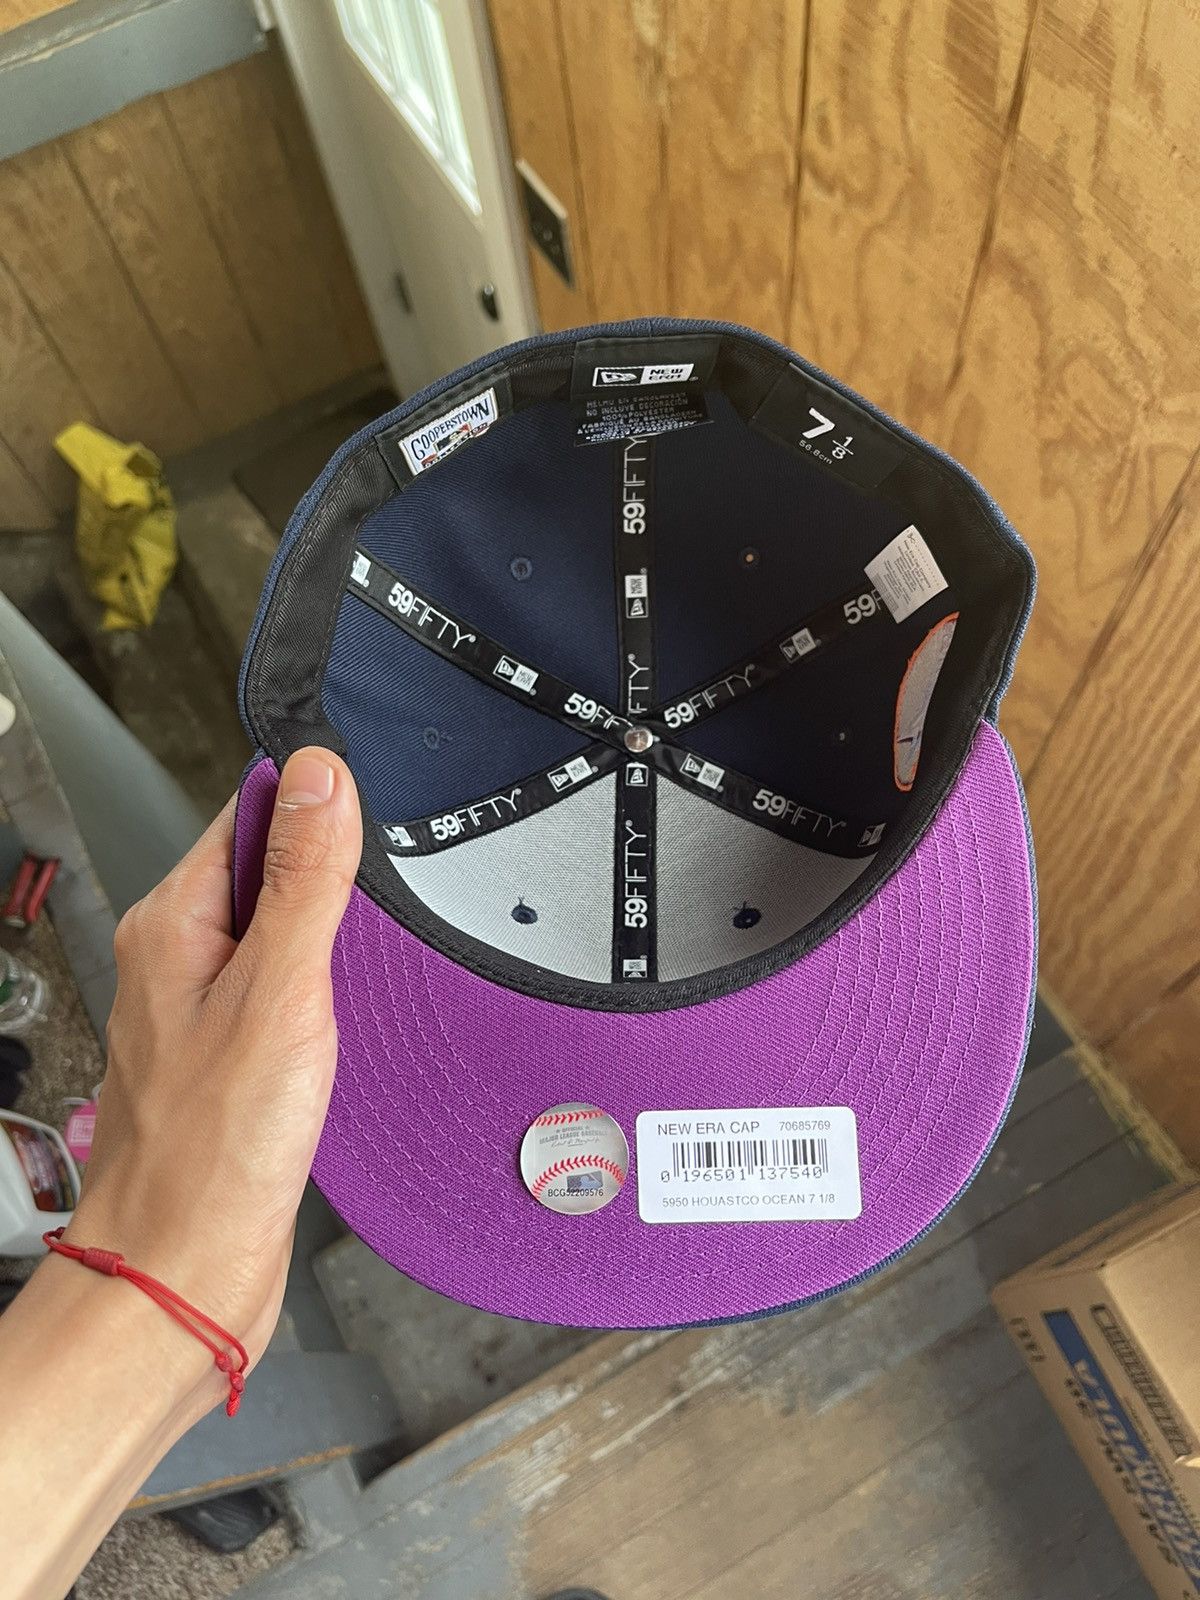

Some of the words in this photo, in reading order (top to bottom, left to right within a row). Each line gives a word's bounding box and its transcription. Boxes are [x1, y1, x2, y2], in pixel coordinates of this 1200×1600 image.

[410, 398, 490, 461] COOPERSTOWN
[802, 407, 836, 439] 7
[798, 439, 833, 464] 56.8cm
[388, 582, 472, 649] 59FIFTY
[663, 665, 751, 729] 59FIFTY
[429, 790, 517, 841] 59FIFTY
[752, 788, 842, 838] 59FIFTY
[624, 826, 648, 929] 59FIFTY
[560, 1131, 580, 1140] LEAGUE
[657, 1123, 692, 1136] NEW
[696, 1122, 726, 1135] ERA
[730, 1121, 760, 1134] CAP
[779, 1120, 831, 1132] 70685769
[660, 1170, 671, 1183] 0
[683, 1168, 746, 1183] 196501
[759, 1166, 823, 1180] 137540
[547, 1188, 604, 1198] BCG52209576
[662, 1197, 689, 1208] 5950
[692, 1195, 760, 1207] HOUASTCO
[762, 1193, 805, 1206] OCEAN
[809, 1193, 816, 1204] 7
[819, 1193, 836, 1204] 1/8
